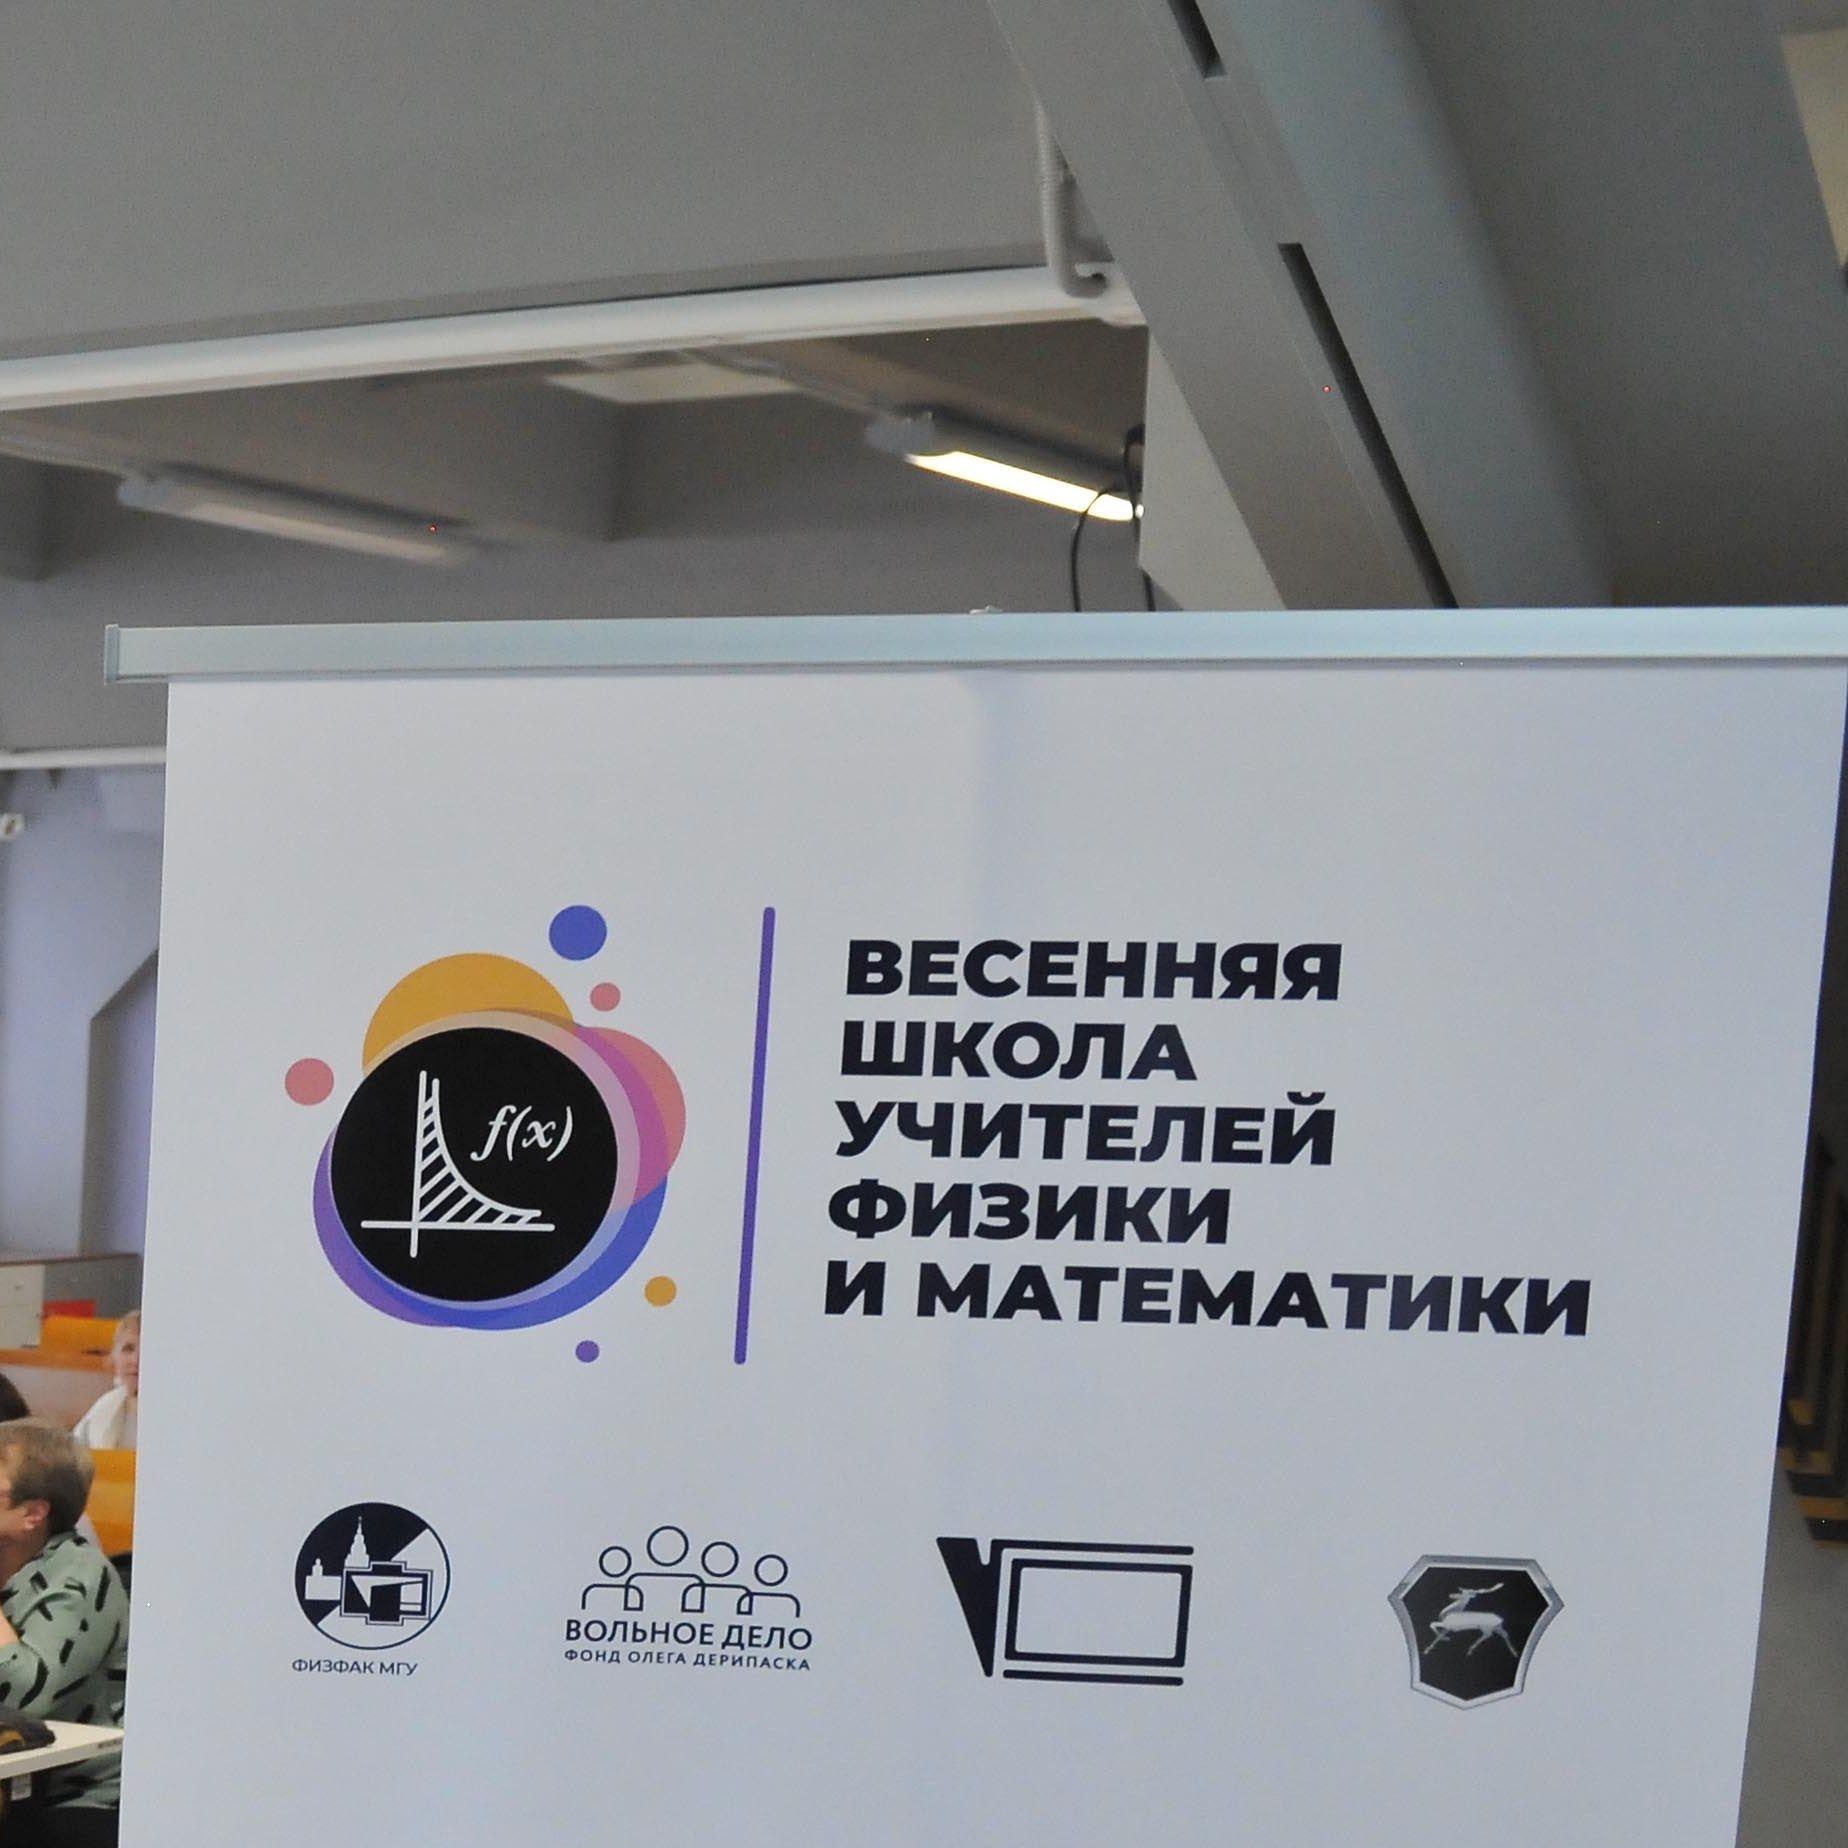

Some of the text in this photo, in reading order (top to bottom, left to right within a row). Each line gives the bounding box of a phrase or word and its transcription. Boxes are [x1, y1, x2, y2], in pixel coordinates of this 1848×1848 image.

[846, 939, 1342, 1001] ВЕСЕННЯЯ
[841, 1020, 1197, 1081] ШКОЛА
[470, 1105, 573, 1161] f(x)
[835, 1091, 1336, 1166] УЧИТЕЛЕЙ
[828, 1178, 1231, 1244] ФИЗИКИ
[825, 1260, 1591, 1336] И МАТЕМАТИКИ
[565, 1649, 810, 1671] ФОНД ОЛЕГА ДЕРИПАСКА
[566, 1619, 812, 1651] ВОЛЬНОЕ ДЕЛО
[292, 1659, 418, 1676] ФИЗФАК МГУ
